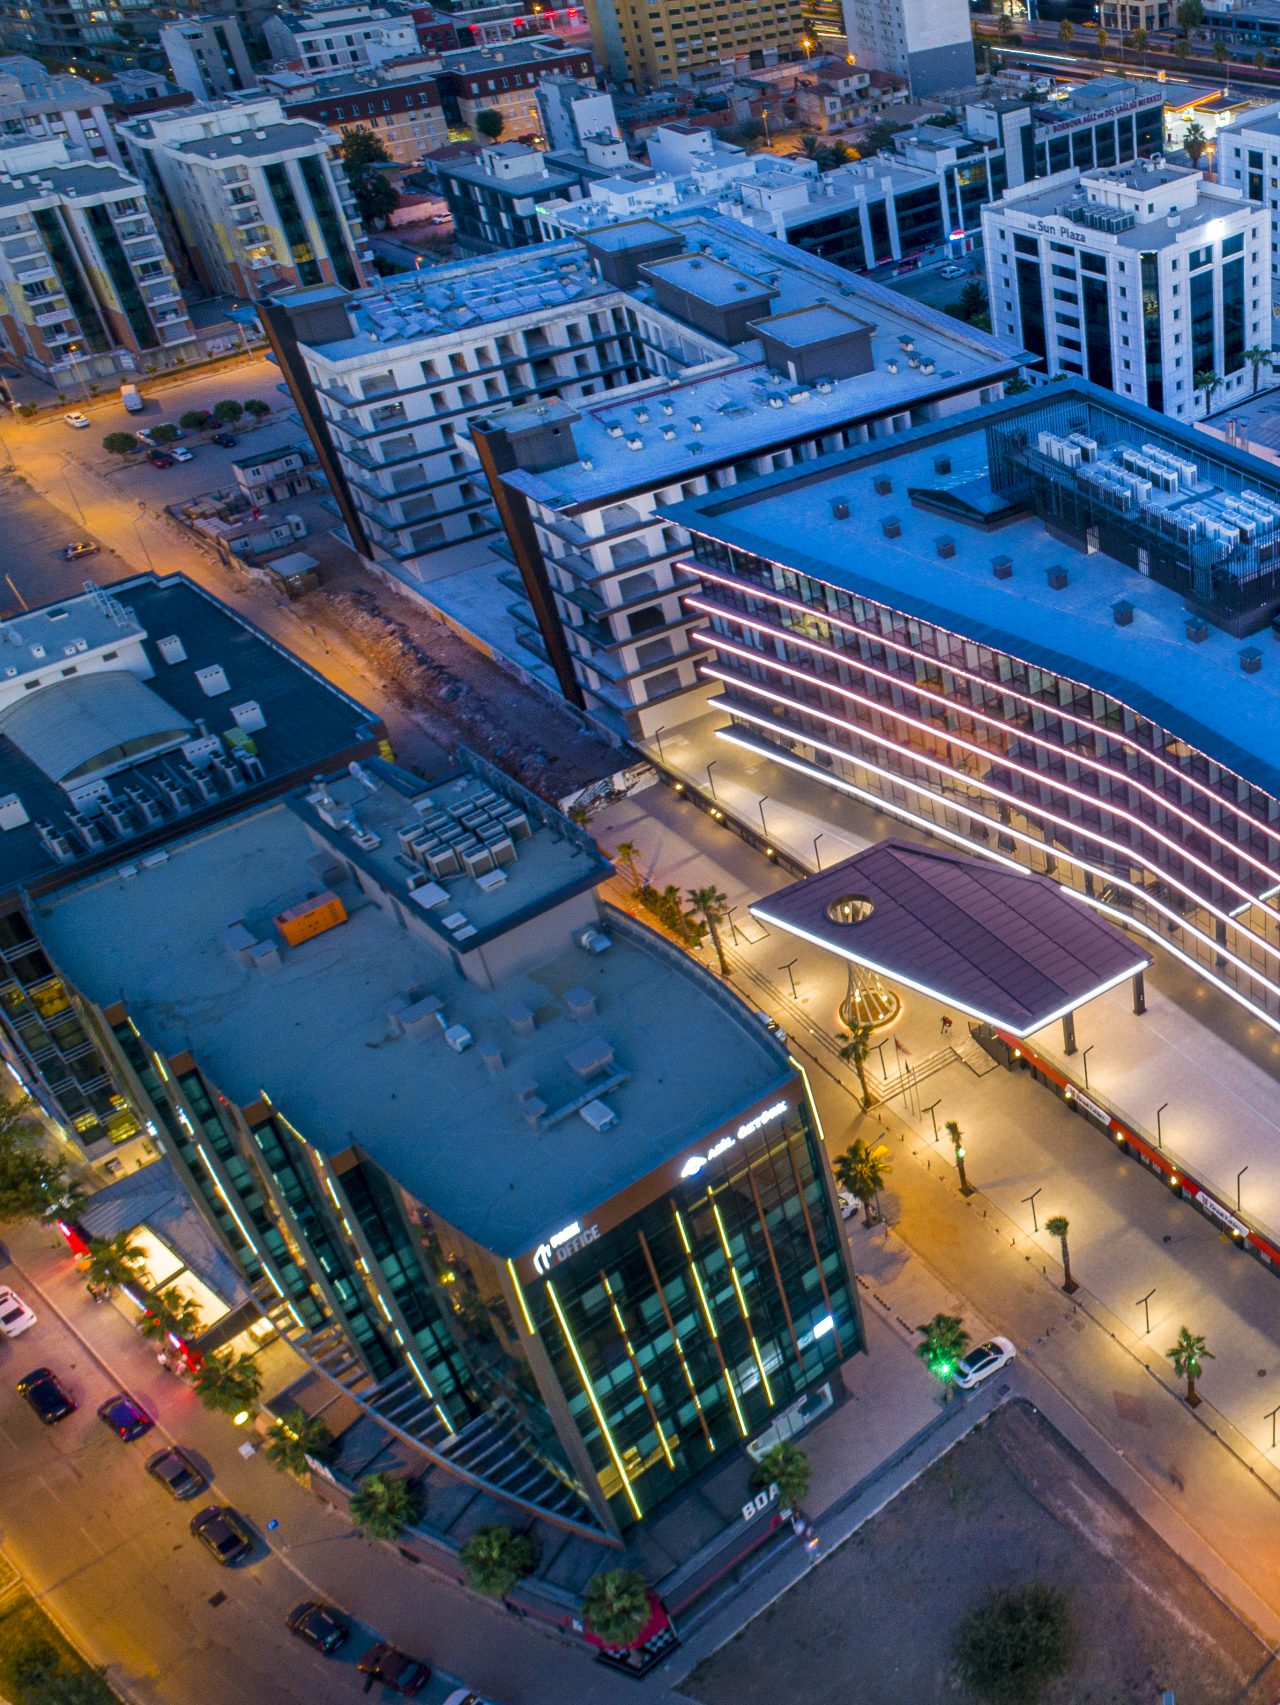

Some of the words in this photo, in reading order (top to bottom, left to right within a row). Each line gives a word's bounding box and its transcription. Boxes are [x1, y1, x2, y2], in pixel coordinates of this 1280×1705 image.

[1053, 118, 1082, 133] BORNOVA
[1083, 112, 1097, 125] AĞIZ
[1037, 220, 1056, 236] Sun
[1060, 226, 1086, 243] Plaza
[556, 1224, 601, 1263] OFFICE
